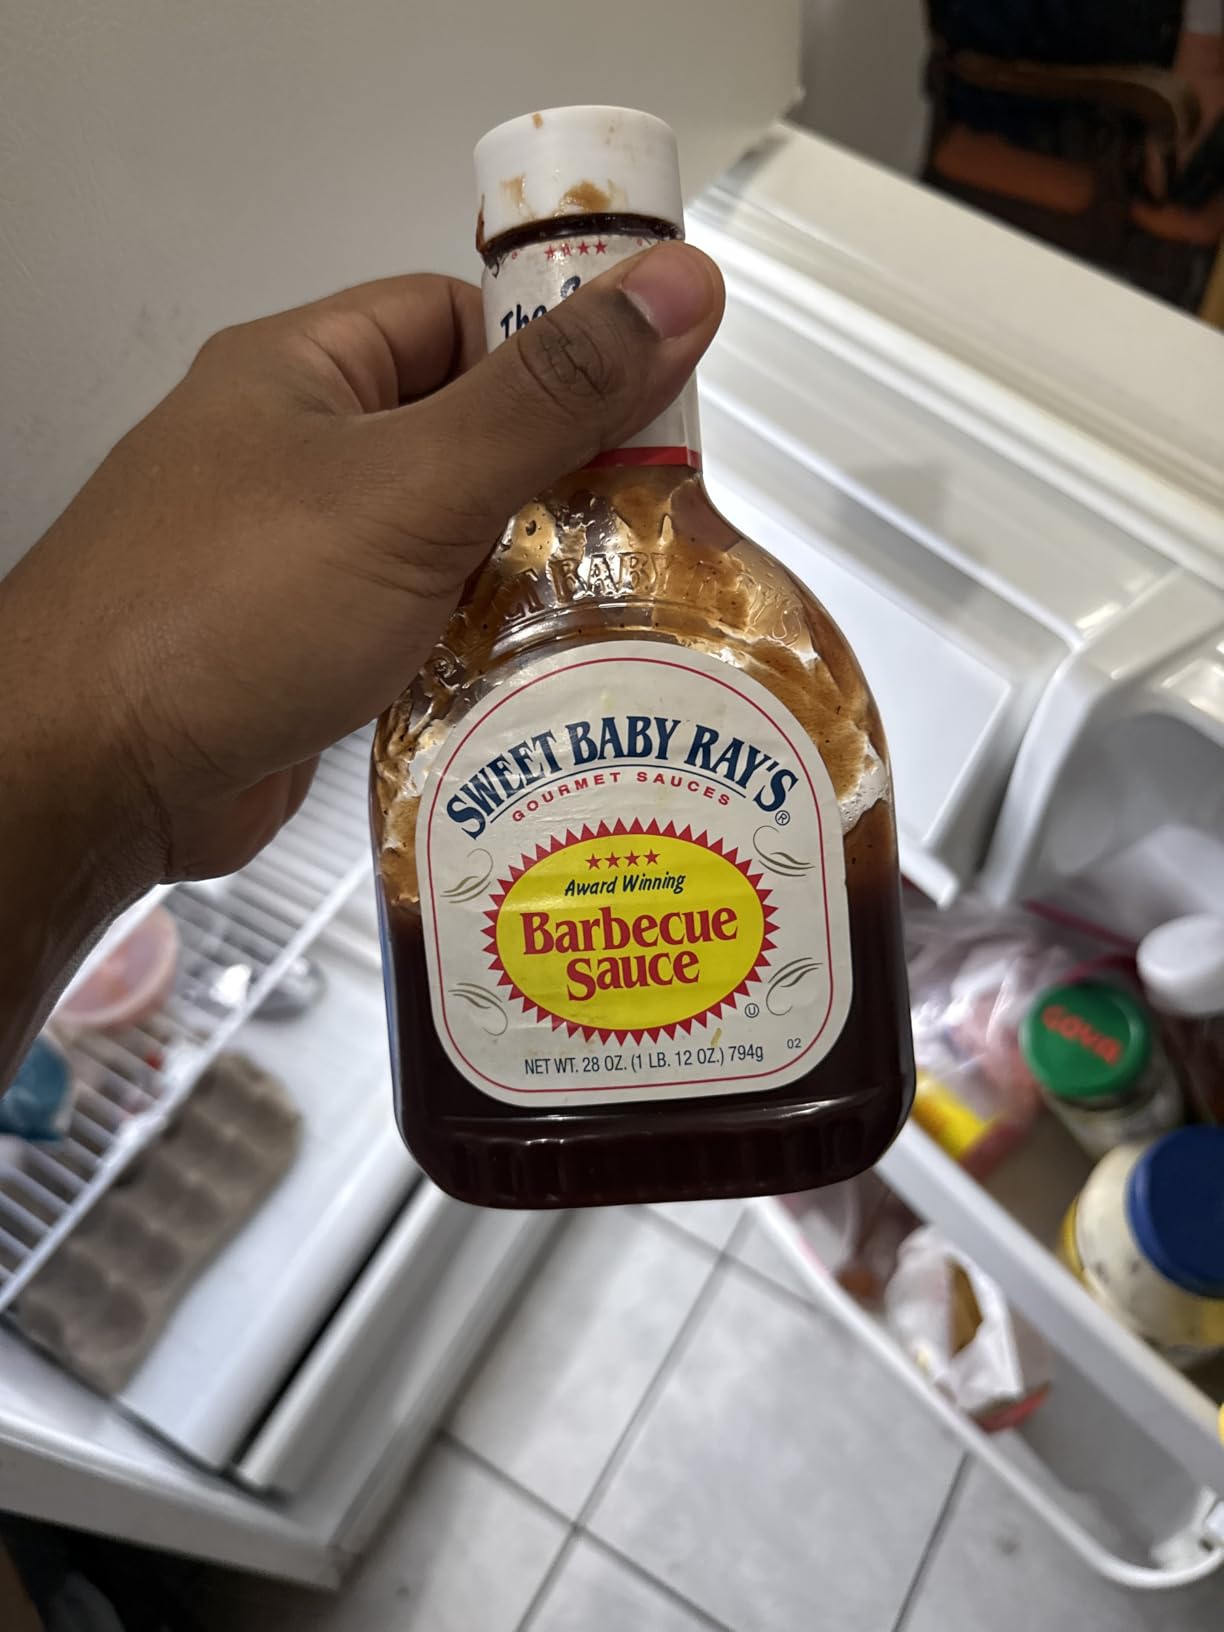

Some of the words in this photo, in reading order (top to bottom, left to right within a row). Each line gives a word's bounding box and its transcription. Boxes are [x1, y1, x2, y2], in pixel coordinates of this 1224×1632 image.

[446, 729, 563, 840] SWEET
[565, 715, 682, 766] BABY
[683, 724, 799, 813] RAY'S
[512, 771, 621, 823] GOURMET
[636, 771, 730, 807] SAUCES
[564, 876, 618, 897] Award
[622, 871, 687, 894] Winning
[519, 906, 739, 956] Barbecue
[566, 950, 700, 1002] Sauce
[524, 1058, 551, 1075] NET
[555, 1057, 579, 1074] WT.
[582, 1056, 600, 1073] 28
[604, 1054, 628, 1071] OZ.
[631, 1054, 643, 1073] (1
[648, 1052, 671, 1068] LB.
[675, 1050, 692, 1066] 12
[697, 1047, 725, 1067] OZ.)
[728, 1044, 764, 1063] 794g
[787, 1037, 802, 1050] 02
